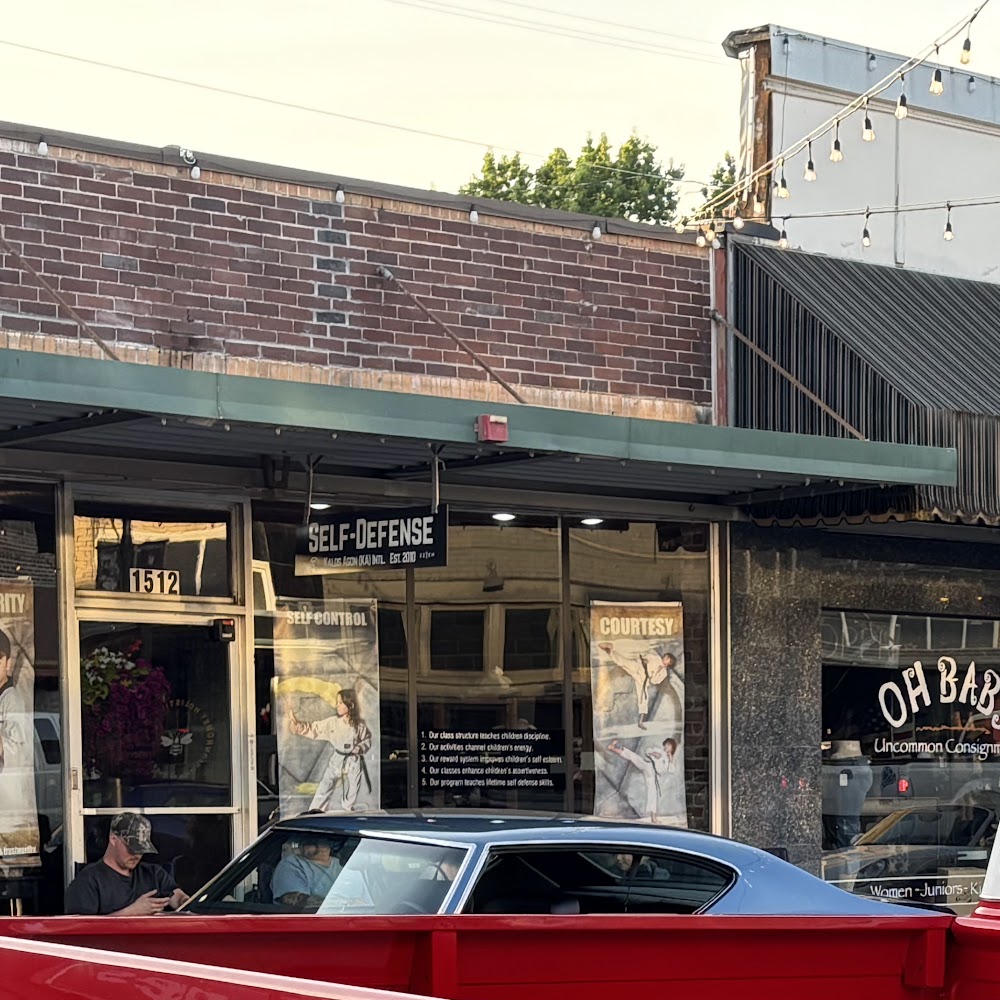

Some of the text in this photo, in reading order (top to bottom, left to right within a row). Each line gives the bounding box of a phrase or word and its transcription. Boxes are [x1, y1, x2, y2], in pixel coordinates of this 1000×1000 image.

[308, 516, 434, 553] SELF-DEFENSE
[401, 551, 416, 564] 2010
[132, 569, 178, 594] 1512
[314, 611, 368, 626] CONTROL
[600, 616, 674, 636] COURTESY
[878, 660, 932, 728] OH
[428, 731, 439, 739] Our
[440, 731, 454, 739] class
[455, 731, 479, 739] structure
[480, 731, 500, 739] teaches
[501, 731, 522, 739] children
[428, 743, 439, 751] Our
[440, 743, 464, 751] activities
[465, 743, 486, 751] channel
[874, 738, 944, 754] Uncommon
[429, 755, 439, 763] Our
[429, 766, 440, 775] Our
[429, 778, 440, 786] Our
[440, 778, 464, 788] program
[464, 778, 486, 786] teaches
[869, 884, 913, 899] Women
